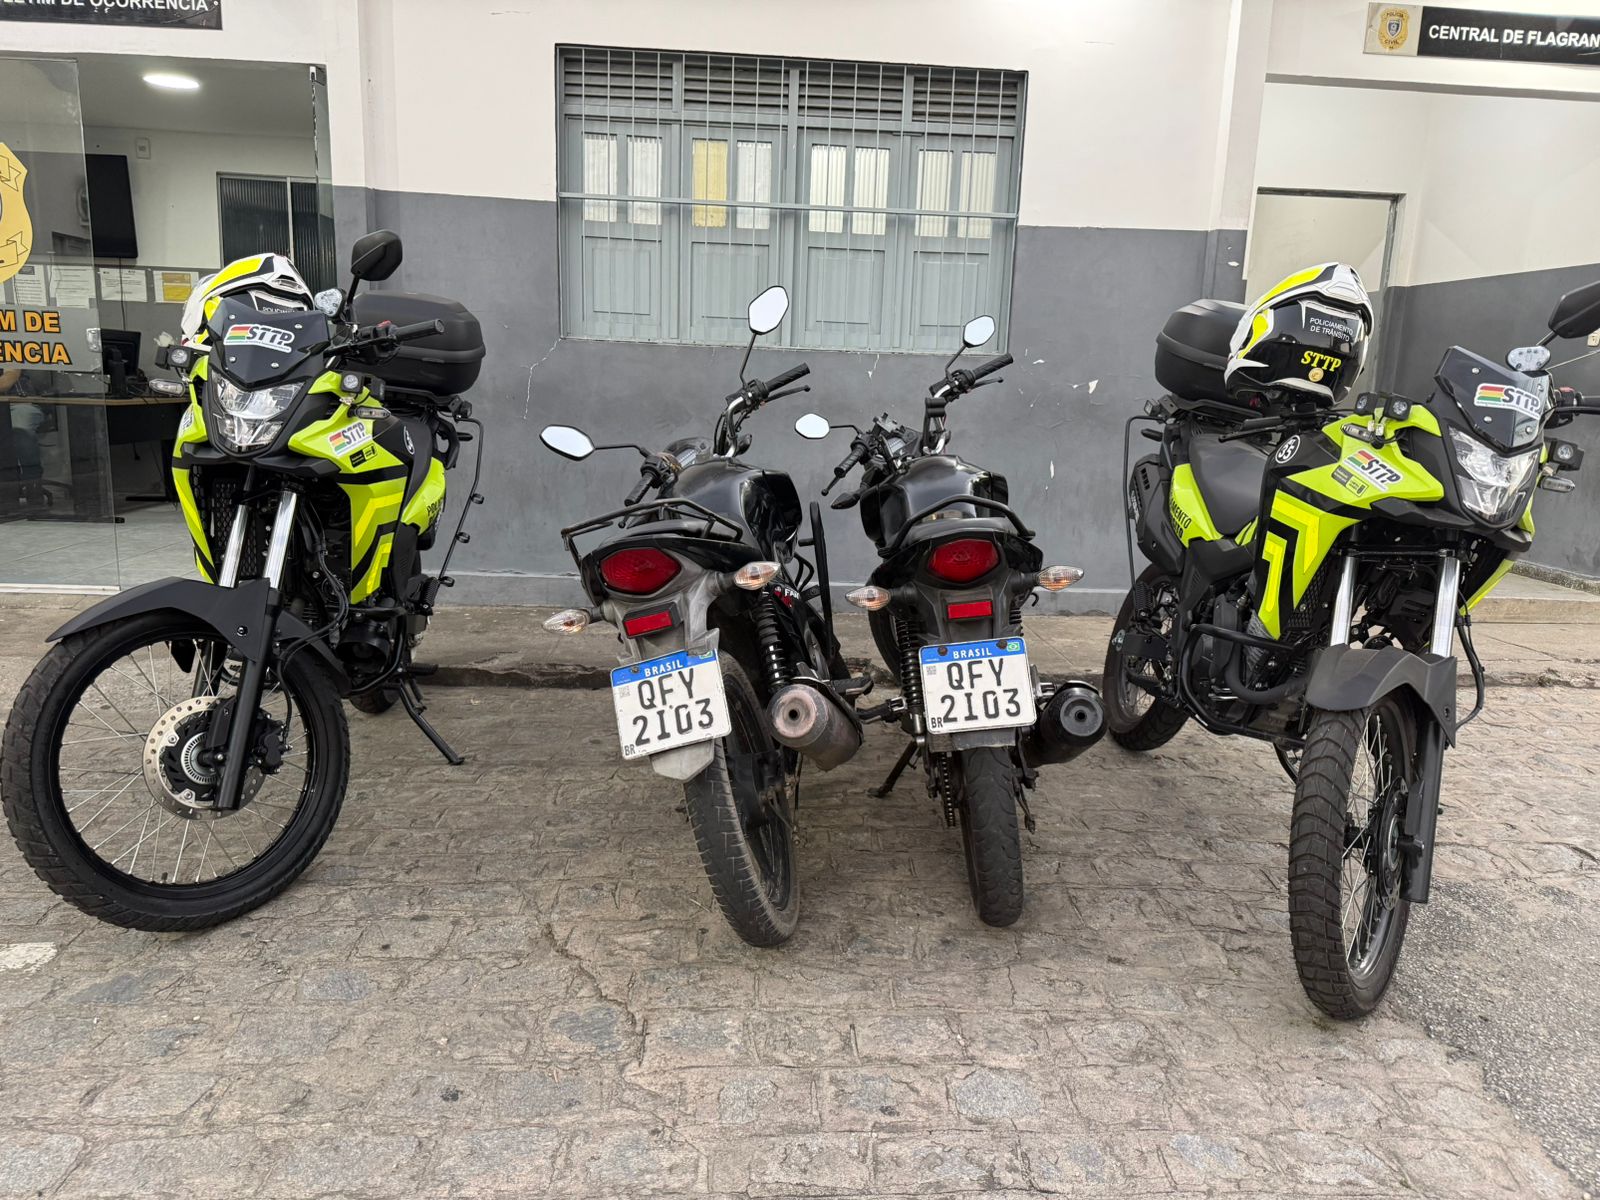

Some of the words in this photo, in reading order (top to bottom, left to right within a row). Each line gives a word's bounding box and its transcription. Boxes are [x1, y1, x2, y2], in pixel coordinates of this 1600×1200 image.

[1428, 25, 1499, 43] CENTRAL
[1502, 29, 1525, 44] DE
[1527, 30, 1600, 48] FLAGRAN
[23, 310, 61, 333] DE
[1309, 317, 1354, 336] POLICIAMENTO
[1310, 325, 1321, 333] DE
[246, 325, 293, 345] STTP
[0, 340, 72, 365] NCIA
[1301, 350, 1342, 373] STTP
[1502, 387, 1540, 411] STTP
[341, 422, 366, 445] STTP
[1278, 444, 1295, 460] 35
[1361, 459, 1401, 484] STTP
[952, 647, 992, 659] BRASIL
[644, 660, 684, 677] BRASIL
[946, 658, 1004, 690] QFY
[638, 668, 694, 710] QFY
[930, 717, 943, 729] BR
[624, 744, 636, 756] BR
